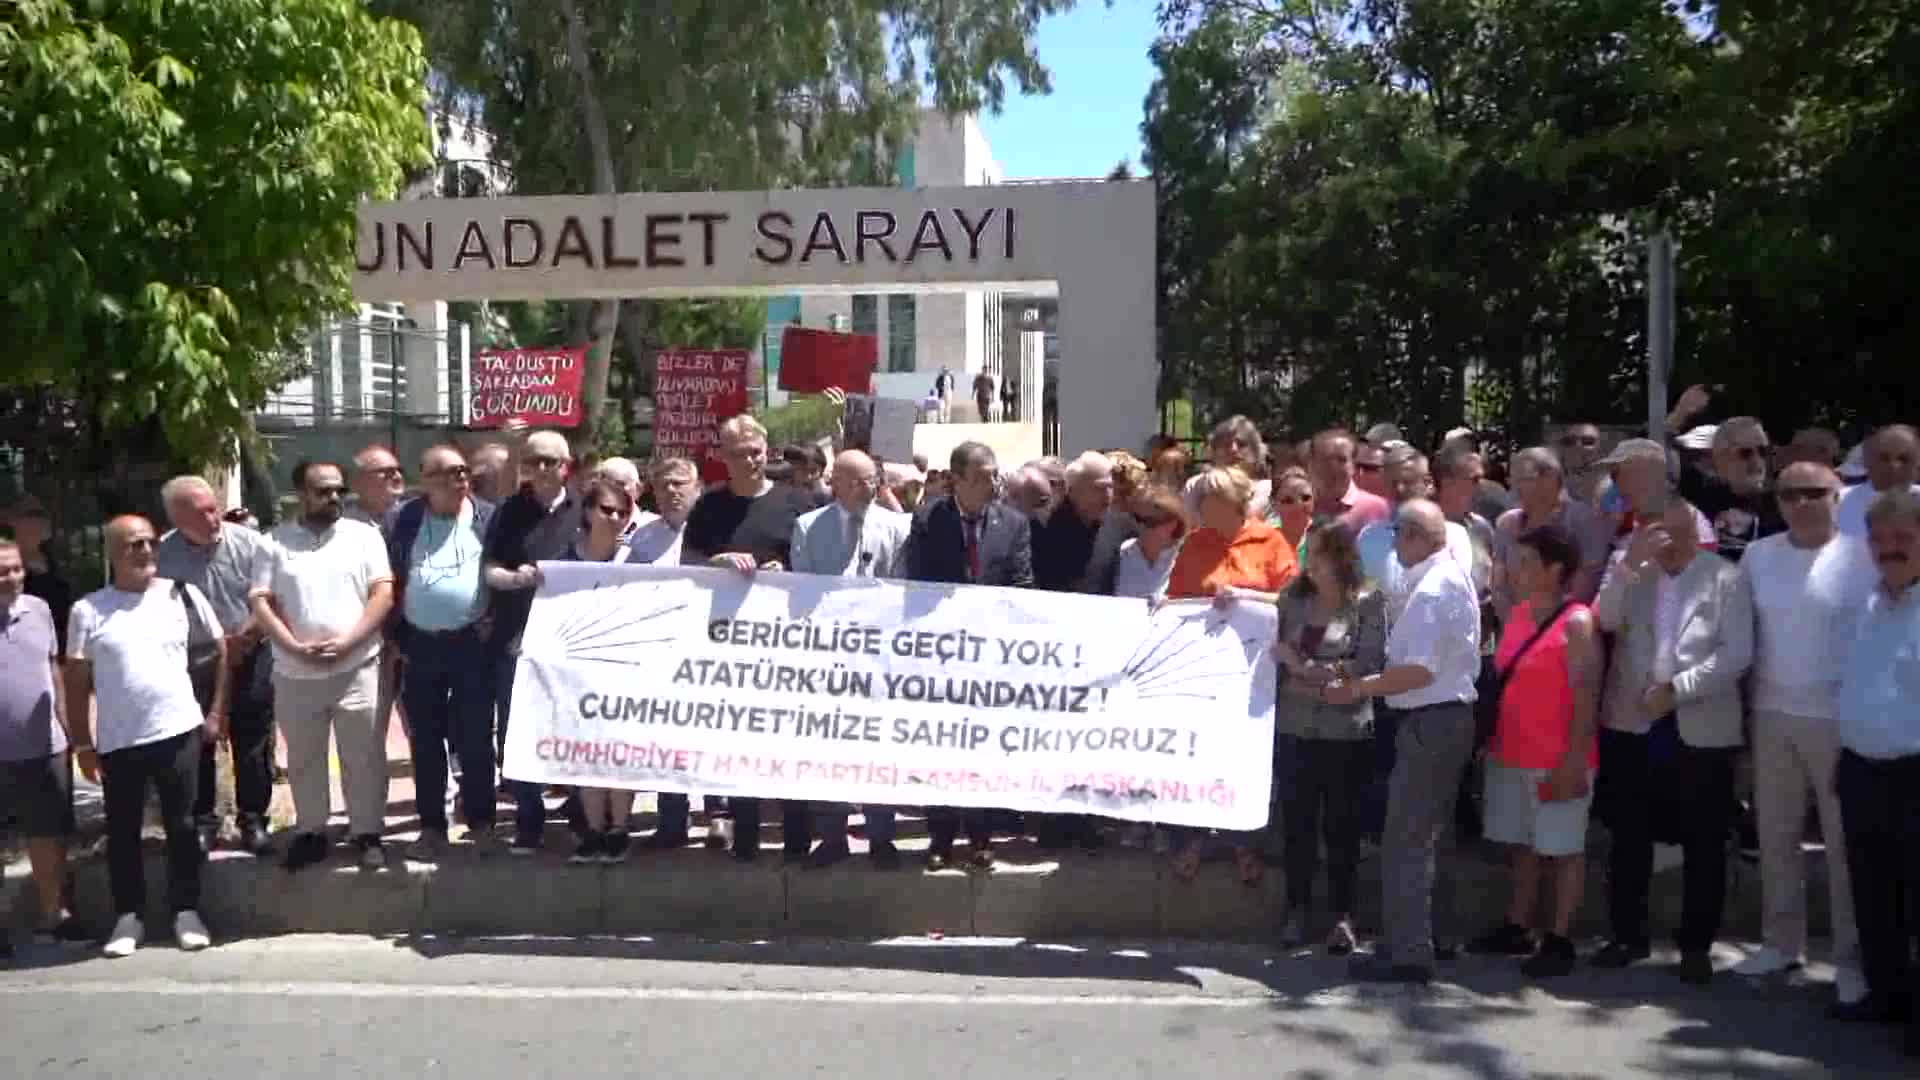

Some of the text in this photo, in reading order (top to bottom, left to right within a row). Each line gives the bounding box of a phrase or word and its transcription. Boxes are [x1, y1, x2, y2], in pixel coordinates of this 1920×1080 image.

[452, 212, 729, 271] ADALET
[755, 206, 1014, 267] SARAYI
[708, 616, 1082, 668] GERİCİLİĞE GEÇİT YOK !
[672, 658, 873, 698] ATATÜRK'ÜN
[885, 674, 1090, 713] YOLUNDAYIZ
[579, 693, 1198, 757] CUMHURİYET'İMİZE SAHİP ÇIKIYORUZ !
[536, 738, 703, 773] CUMHURİYET
[713, 753, 786, 778] HALK
